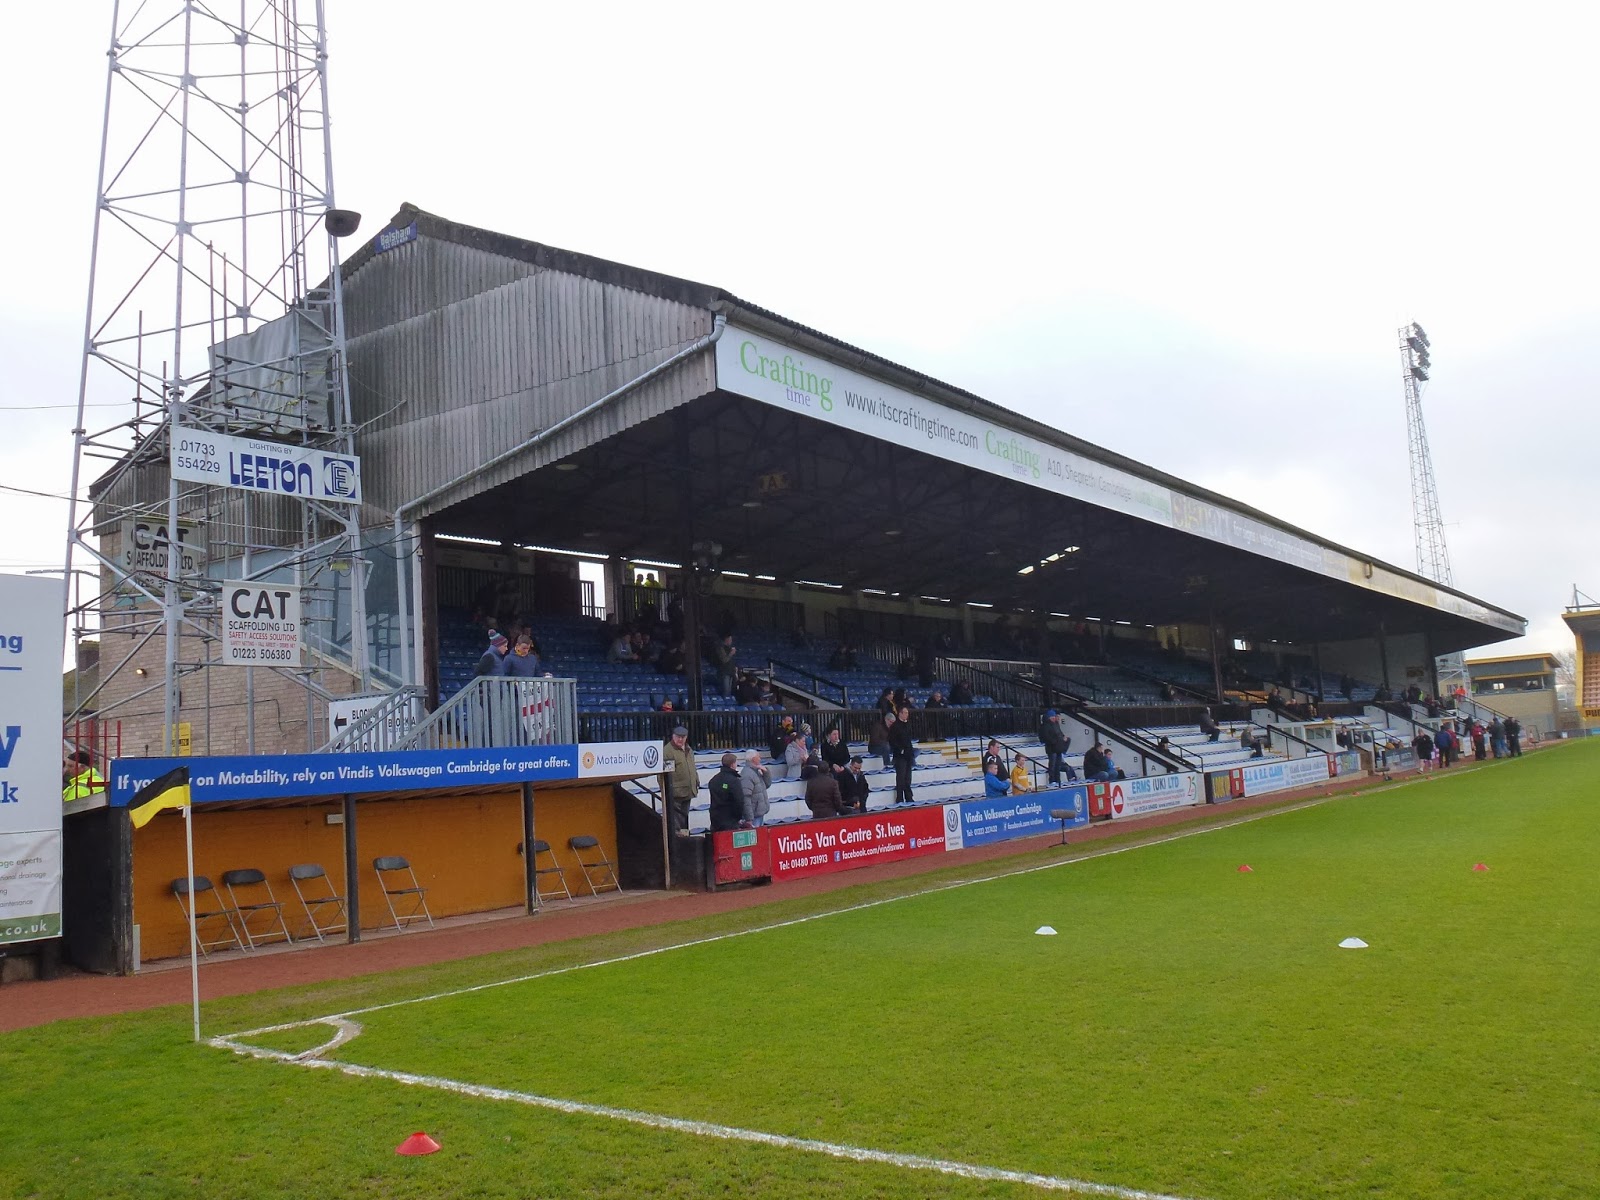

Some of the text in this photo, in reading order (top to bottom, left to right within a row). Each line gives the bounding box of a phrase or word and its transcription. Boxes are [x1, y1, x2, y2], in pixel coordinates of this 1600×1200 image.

[739, 340, 833, 412] Crafting
[785, 385, 811, 407] time
[844, 389, 979, 450] www.itscraftingtime.com
[180, 440, 216, 456] 01733
[249, 442, 293, 455] LIGHTING BY
[985, 429, 1041, 479] Crafting
[177, 456, 220, 473] 554229
[231, 588, 291, 620] CAT
[228, 620, 295, 632] SCAFFOLDING LTD
[228, 631, 297, 642] SAFETY ACCESS SOLUTIONS
[232, 648, 291, 660] 01223 506380
[596, 753, 639, 766] Motability
[117, 774, 130, 790] If
[196, 775, 214, 786] on
[218, 768, 290, 787] Motability,
[293, 767, 317, 784] rely
[319, 769, 335, 780] on
[338, 765, 375, 780] Vindis
[378, 763, 443, 779] Volkswagen
[446, 760, 501, 775] Cambridge
[503, 759, 517, 771] for
[518, 758, 542, 773] great
[544, 756, 571, 769] offers.
[1131, 779, 1151, 795] ERMS
[1167, 775, 1179, 789] LTD
[964, 802, 1042, 824] Vindis Volkswagen Cambridge
[777, 833, 813, 854] Vindis
[815, 832, 836, 848] Van
[839, 828, 872, 845] Centre
[17, 857, 42, 866] experts
[779, 860, 790, 871] Tel:
[790, 857, 809, 869] 01480
[809, 853, 828, 866] 731913
[18, 871, 47, 880] drainage
